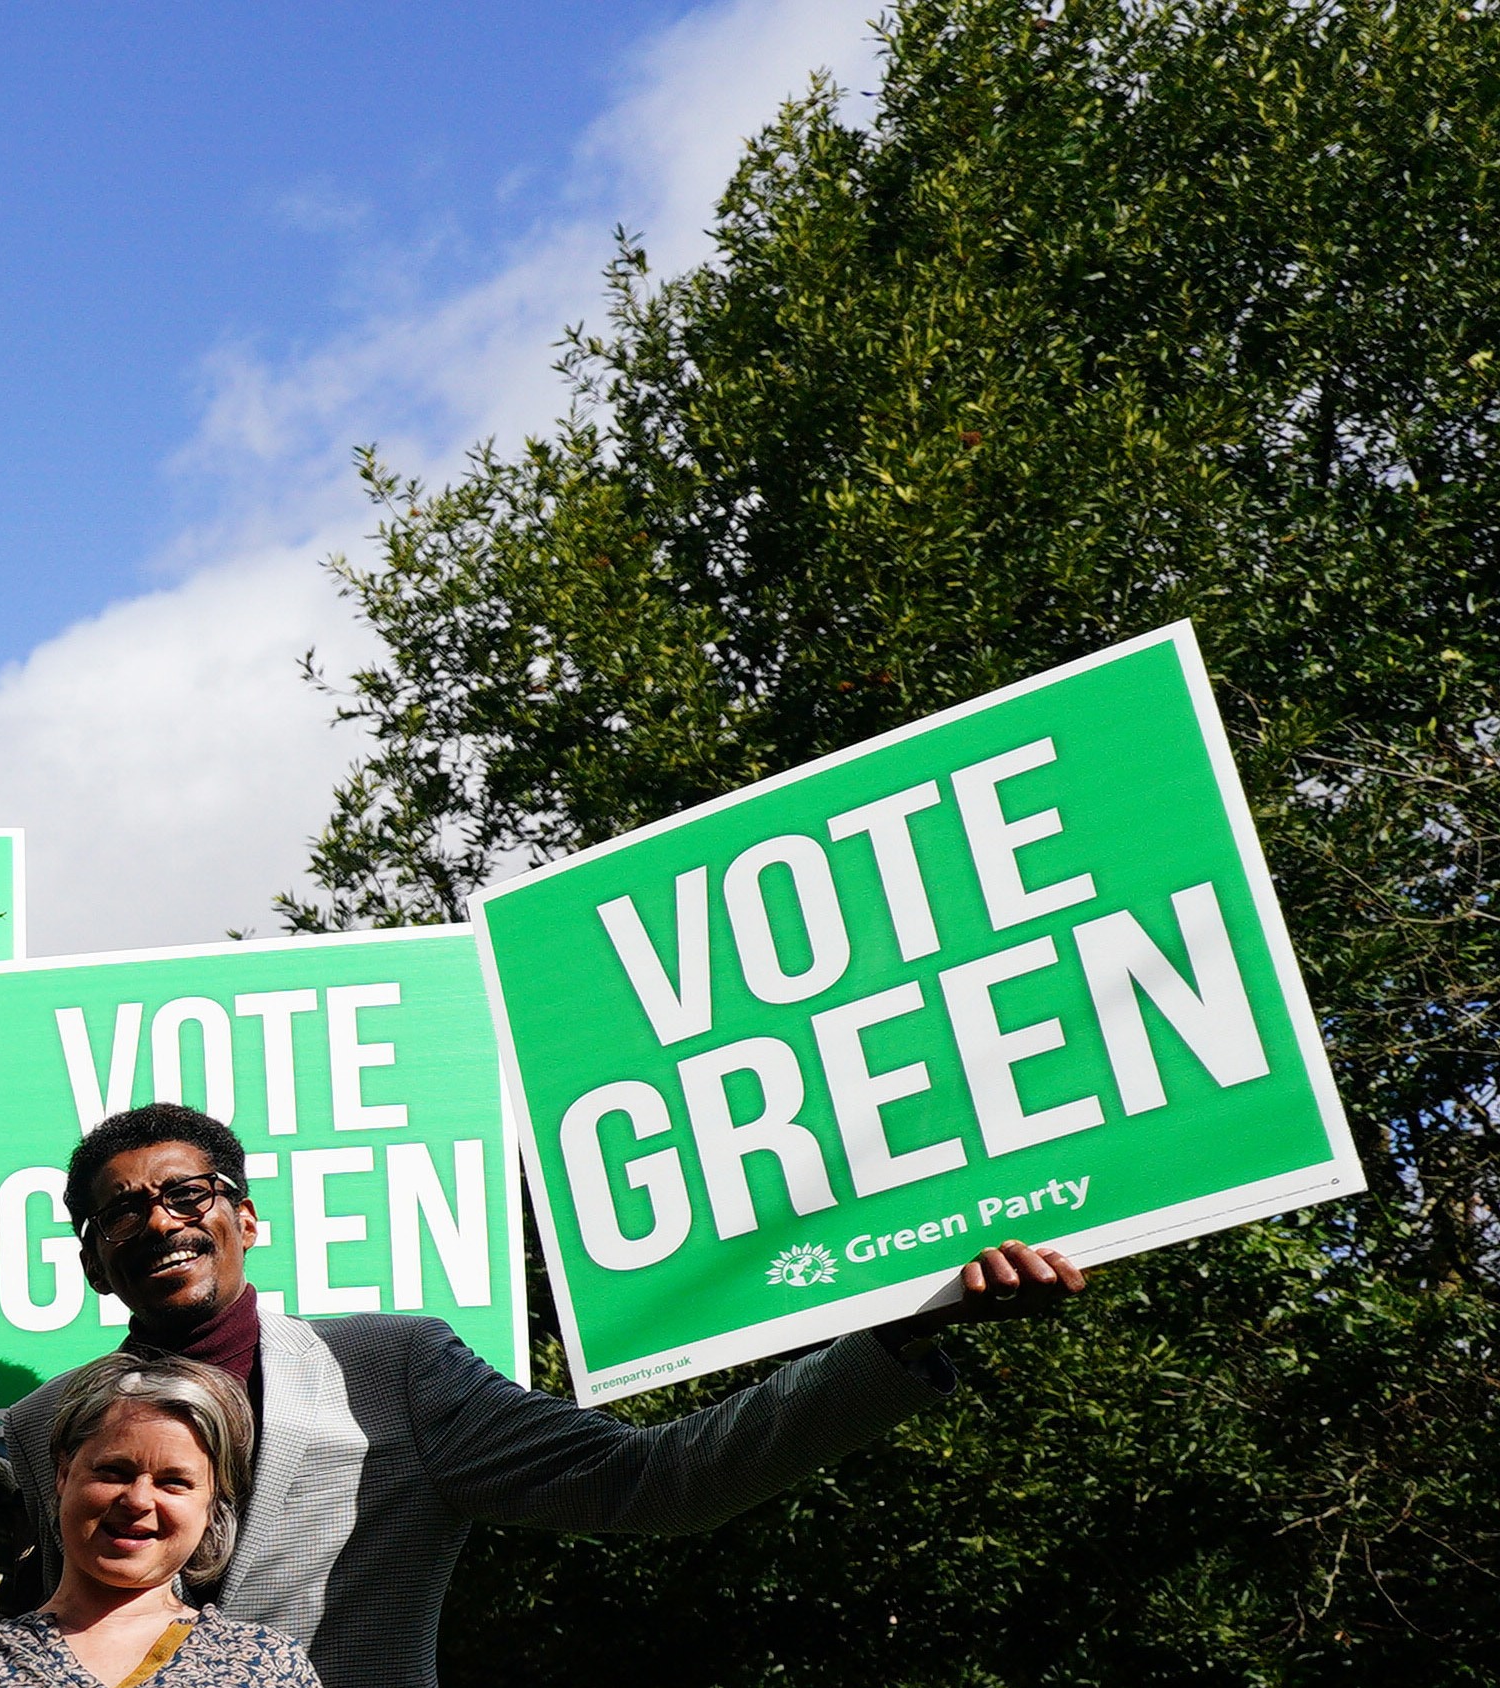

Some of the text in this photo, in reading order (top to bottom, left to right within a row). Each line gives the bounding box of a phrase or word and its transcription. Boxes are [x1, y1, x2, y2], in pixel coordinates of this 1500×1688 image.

[595, 737, 1097, 1048] VOTE
[54, 983, 408, 1138] VOTE
[558, 881, 1271, 1272] GREEN
[847, 1210, 968, 1264] Green
[980, 1175, 1091, 1231] Party
[590, 1355, 692, 1395] greenparty.org.uk
